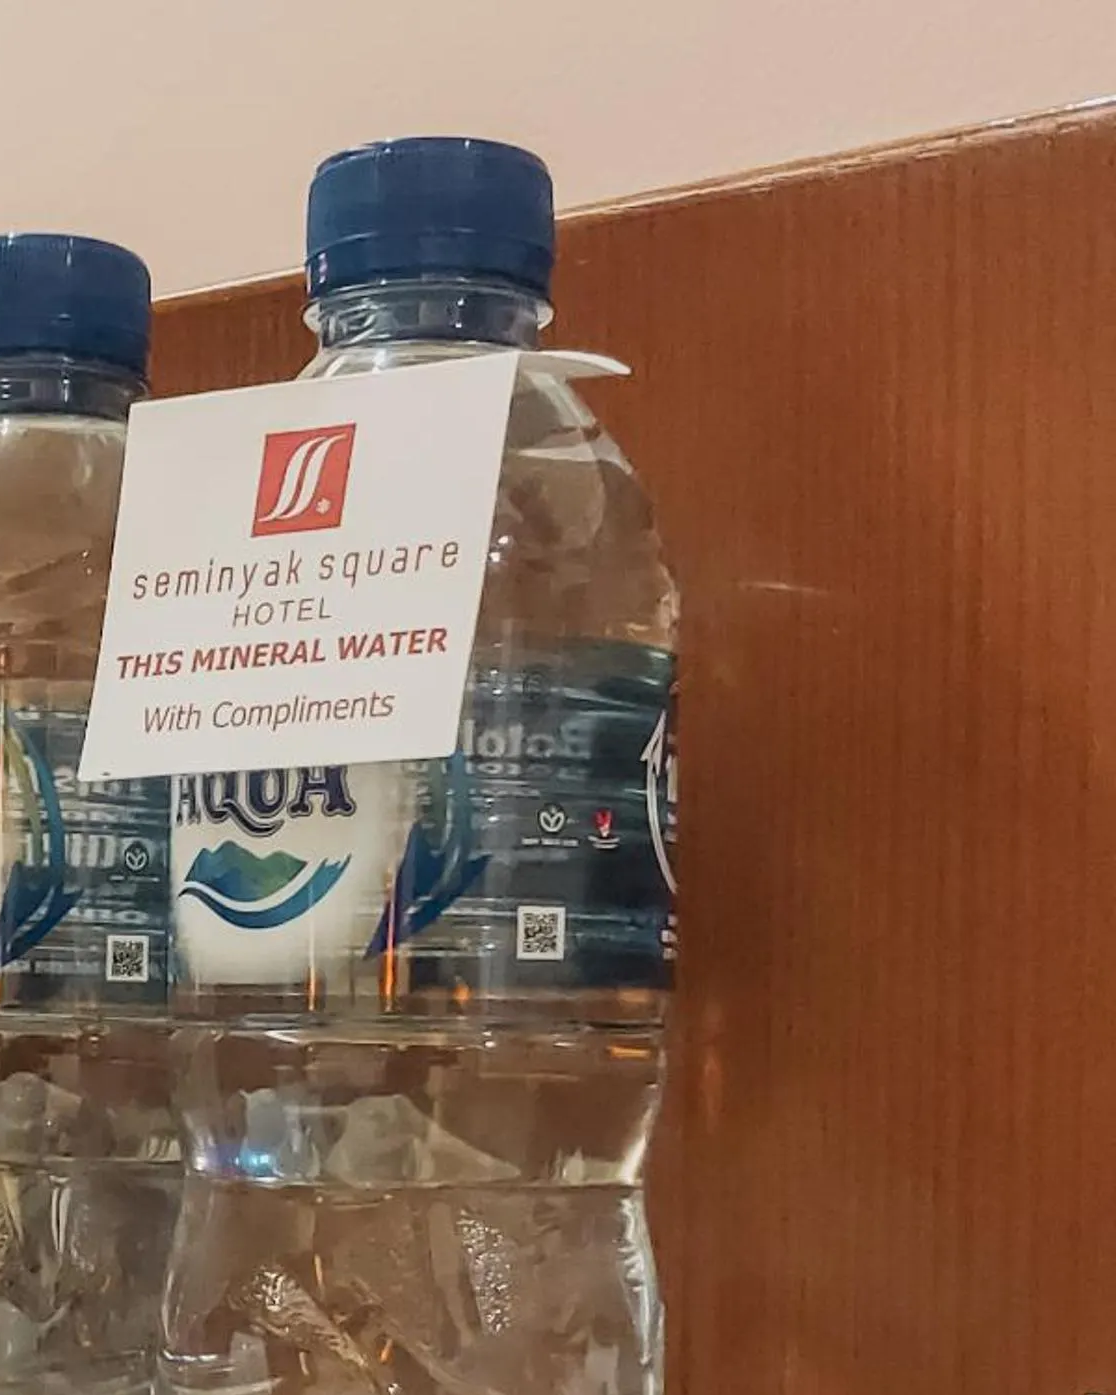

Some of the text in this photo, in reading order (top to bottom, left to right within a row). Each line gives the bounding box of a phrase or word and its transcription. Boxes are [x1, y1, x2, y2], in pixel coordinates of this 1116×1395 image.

[133, 541, 459, 600] seminyak square
[232, 597, 333, 626] HOTEL
[117, 628, 448, 680] THIS MINERAL WATER
[144, 691, 395, 734] With Compliments
